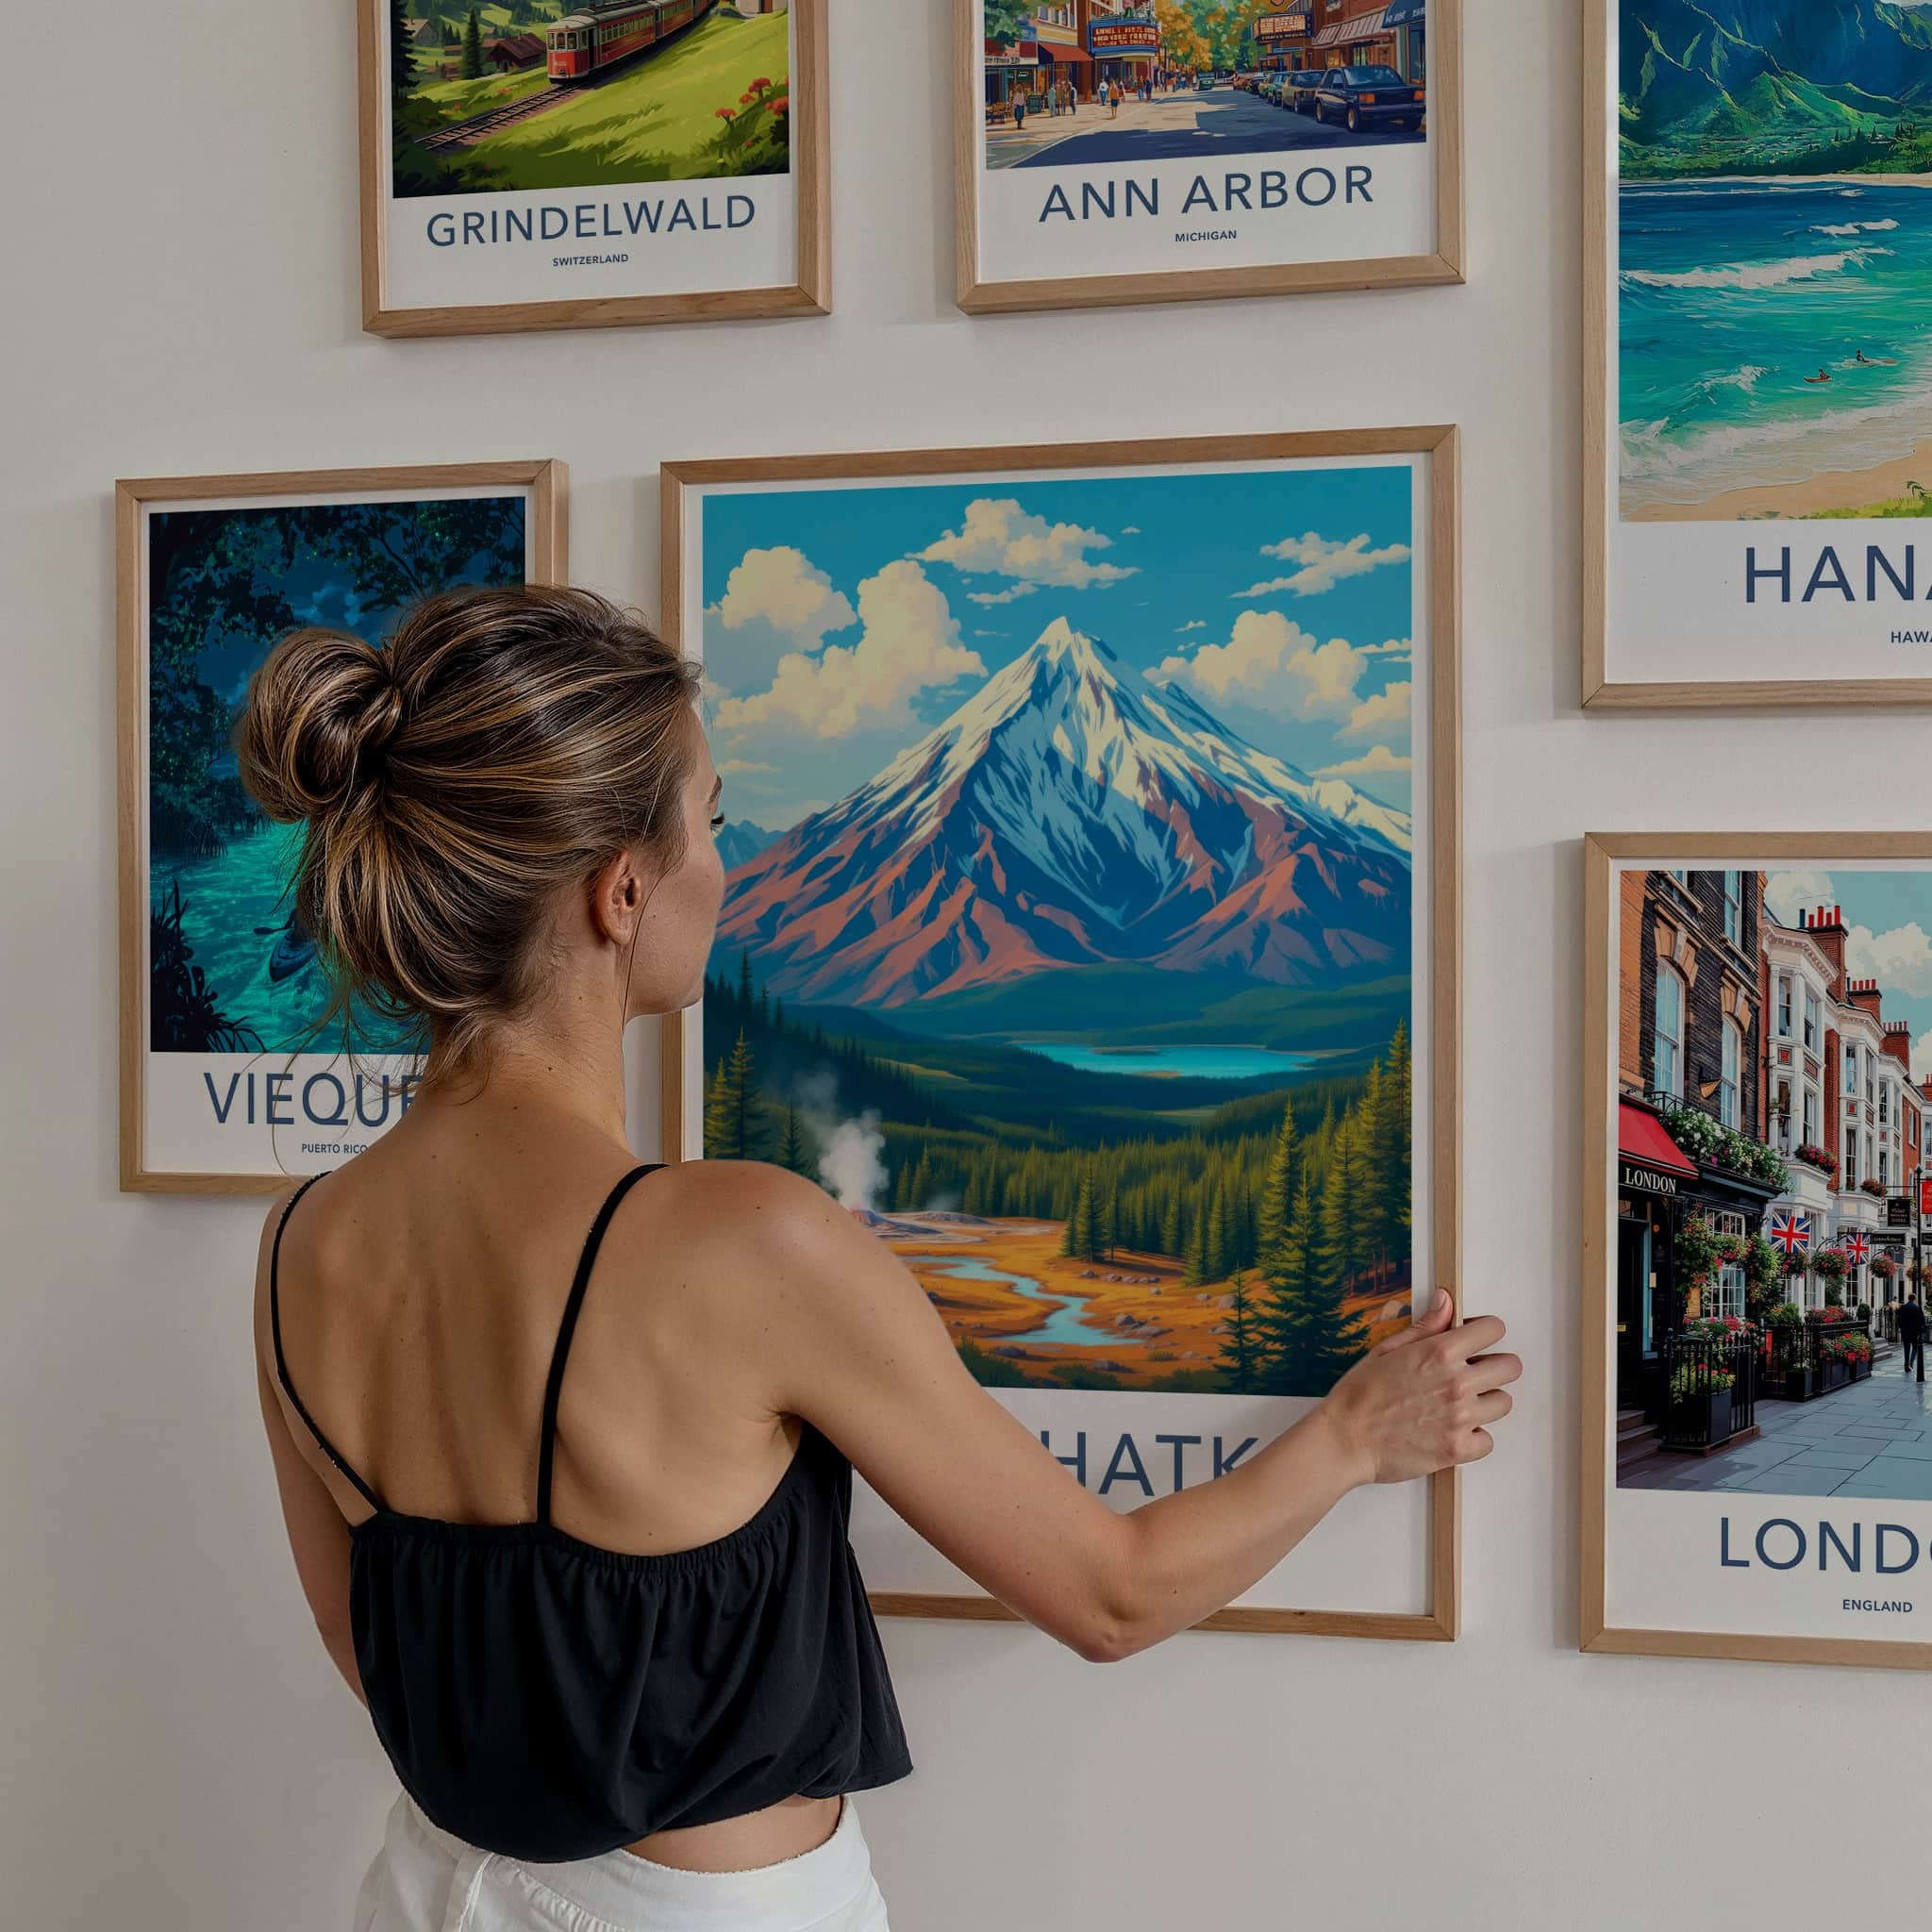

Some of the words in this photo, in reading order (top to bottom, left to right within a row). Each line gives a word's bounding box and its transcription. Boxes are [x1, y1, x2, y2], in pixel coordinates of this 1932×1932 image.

[1039, 178, 1158, 223] ANN
[1181, 165, 1374, 214] ARBOR
[426, 194, 756, 247] GRINDELWALD
[1174, 230, 1238, 242] MICHIGAN
[552, 254, 629, 267] SWITZERLAND
[1745, 544, 1932, 604] HAN
[1890, 630, 1932, 644] HAW
[301, 1143, 341, 1154] PUERTO
[343, 1143, 368, 1155] RICO
[1624, 1167, 1676, 1194] LONDON
[1721, 1516, 1932, 1574] LOND
[1842, 1599, 1913, 1613] ENGLAND
